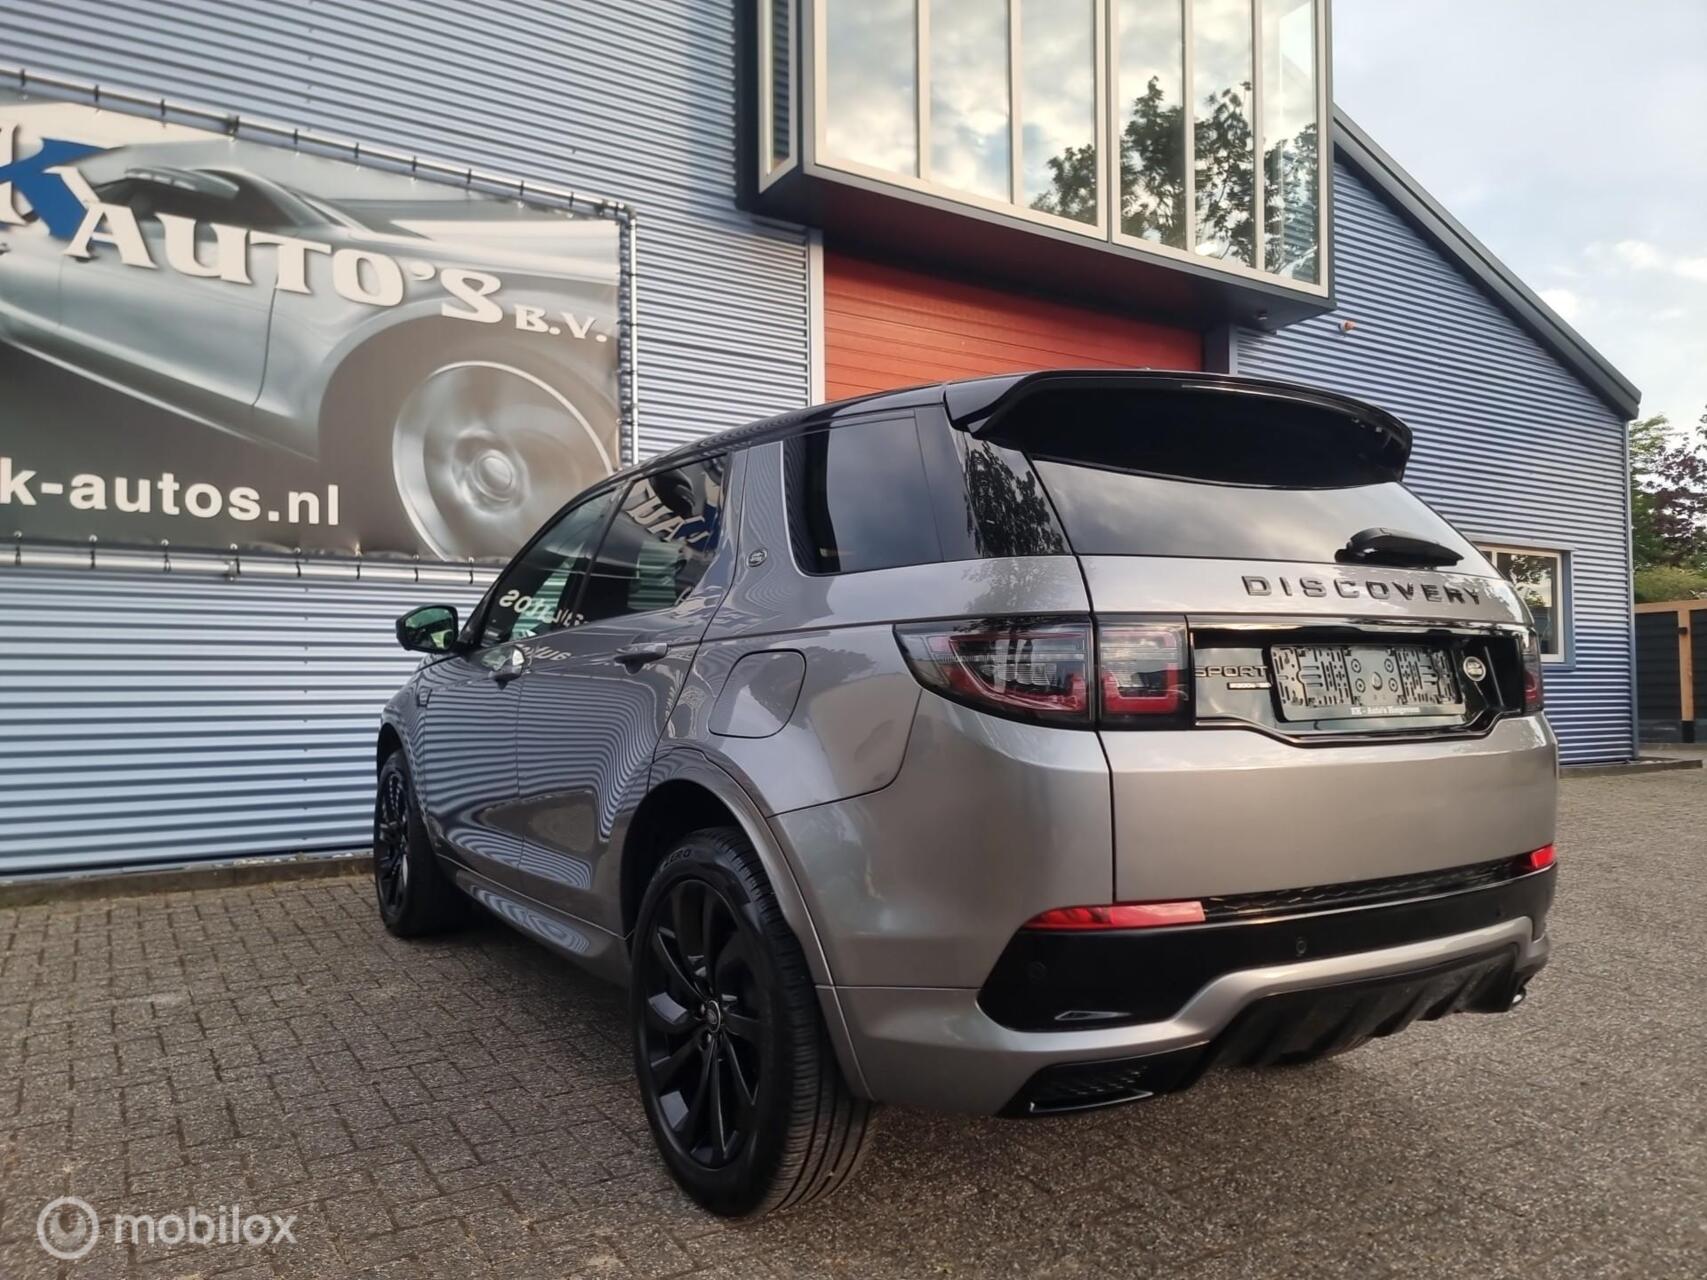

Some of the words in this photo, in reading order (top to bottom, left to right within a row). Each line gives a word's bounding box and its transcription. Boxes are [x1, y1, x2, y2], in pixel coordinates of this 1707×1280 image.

[514, 304, 608, 342] B.V.
[1241, 574, 1482, 605] DISCOVERY
[1193, 665, 1269, 678] SPORT
